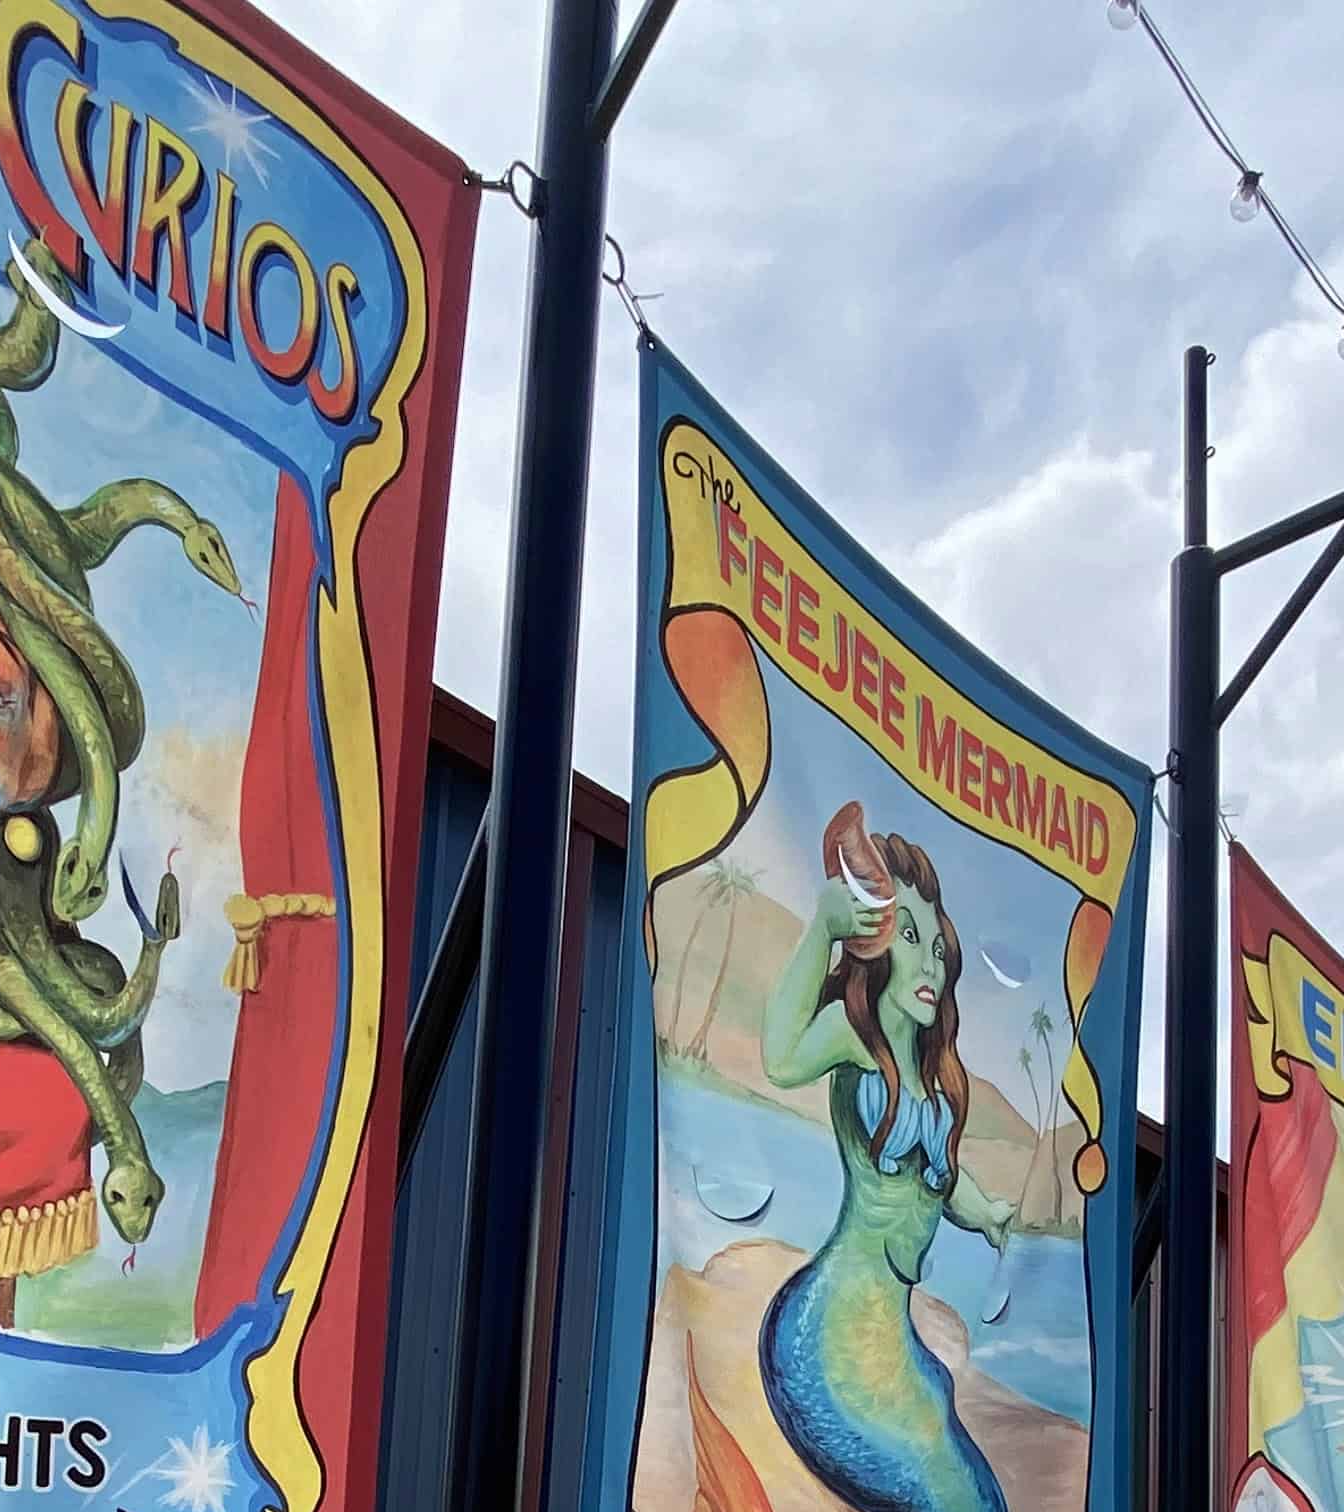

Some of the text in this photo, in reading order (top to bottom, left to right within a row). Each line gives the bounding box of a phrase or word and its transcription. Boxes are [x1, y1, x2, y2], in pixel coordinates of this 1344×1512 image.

[673, 452, 741, 514] The
[717, 502, 1110, 876] FEEJEE MERMAID
